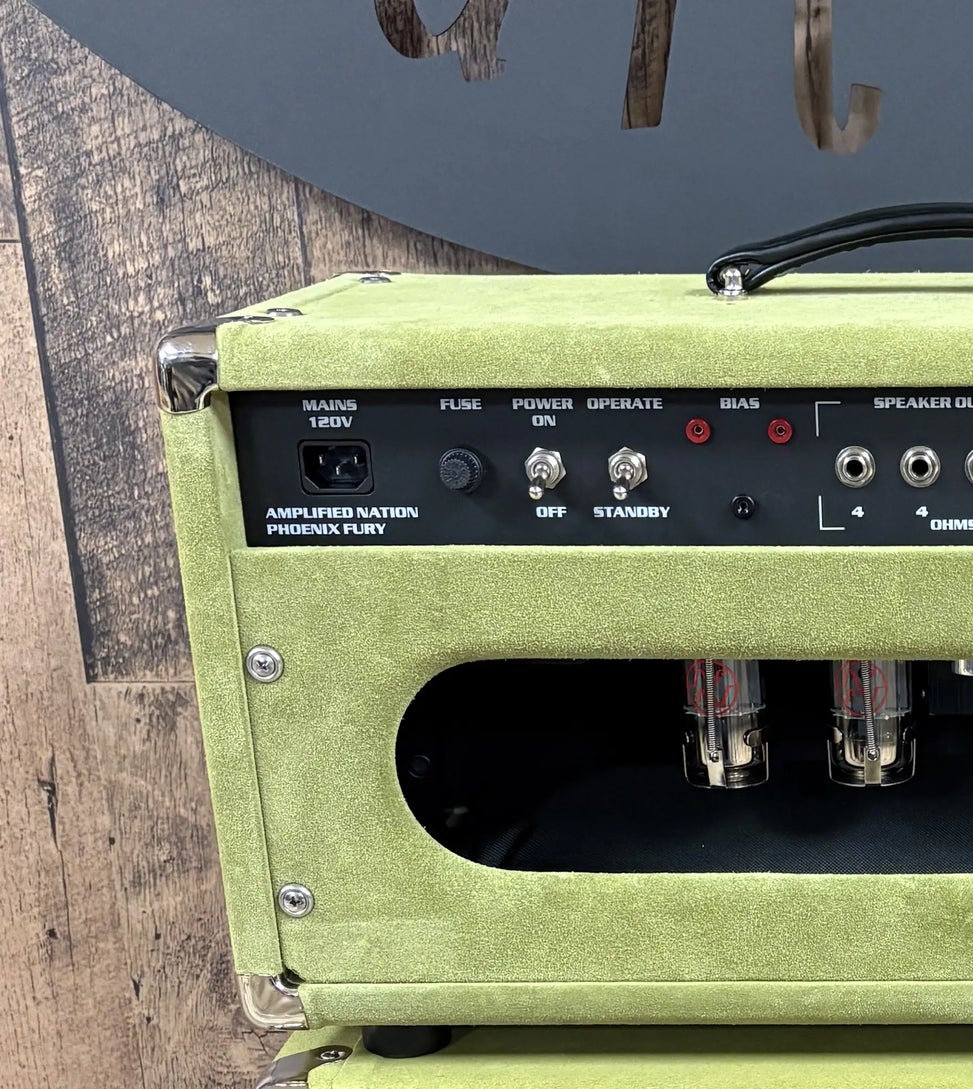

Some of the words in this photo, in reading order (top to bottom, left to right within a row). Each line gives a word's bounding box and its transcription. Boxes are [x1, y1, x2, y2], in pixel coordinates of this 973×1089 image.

[302, 400, 358, 411] MAINS
[440, 399, 482, 410] FUSE
[512, 398, 574, 410] POWER
[587, 398, 663, 410] OPERATE
[720, 398, 760, 409] BIAS
[874, 397, 951, 409] SPEAKER
[309, 416, 353, 428] 120V
[532, 415, 556, 427] ON
[266, 507, 354, 519] AMPLIFIED
[356, 507, 419, 519] NATION
[536, 506, 567, 518] OFF
[593, 506, 671, 518] STANDBY
[851, 506, 865, 518] 4
[916, 506, 929, 517] 4
[267, 523, 340, 535] PHOENIX
[343, 523, 387, 535] FURY
